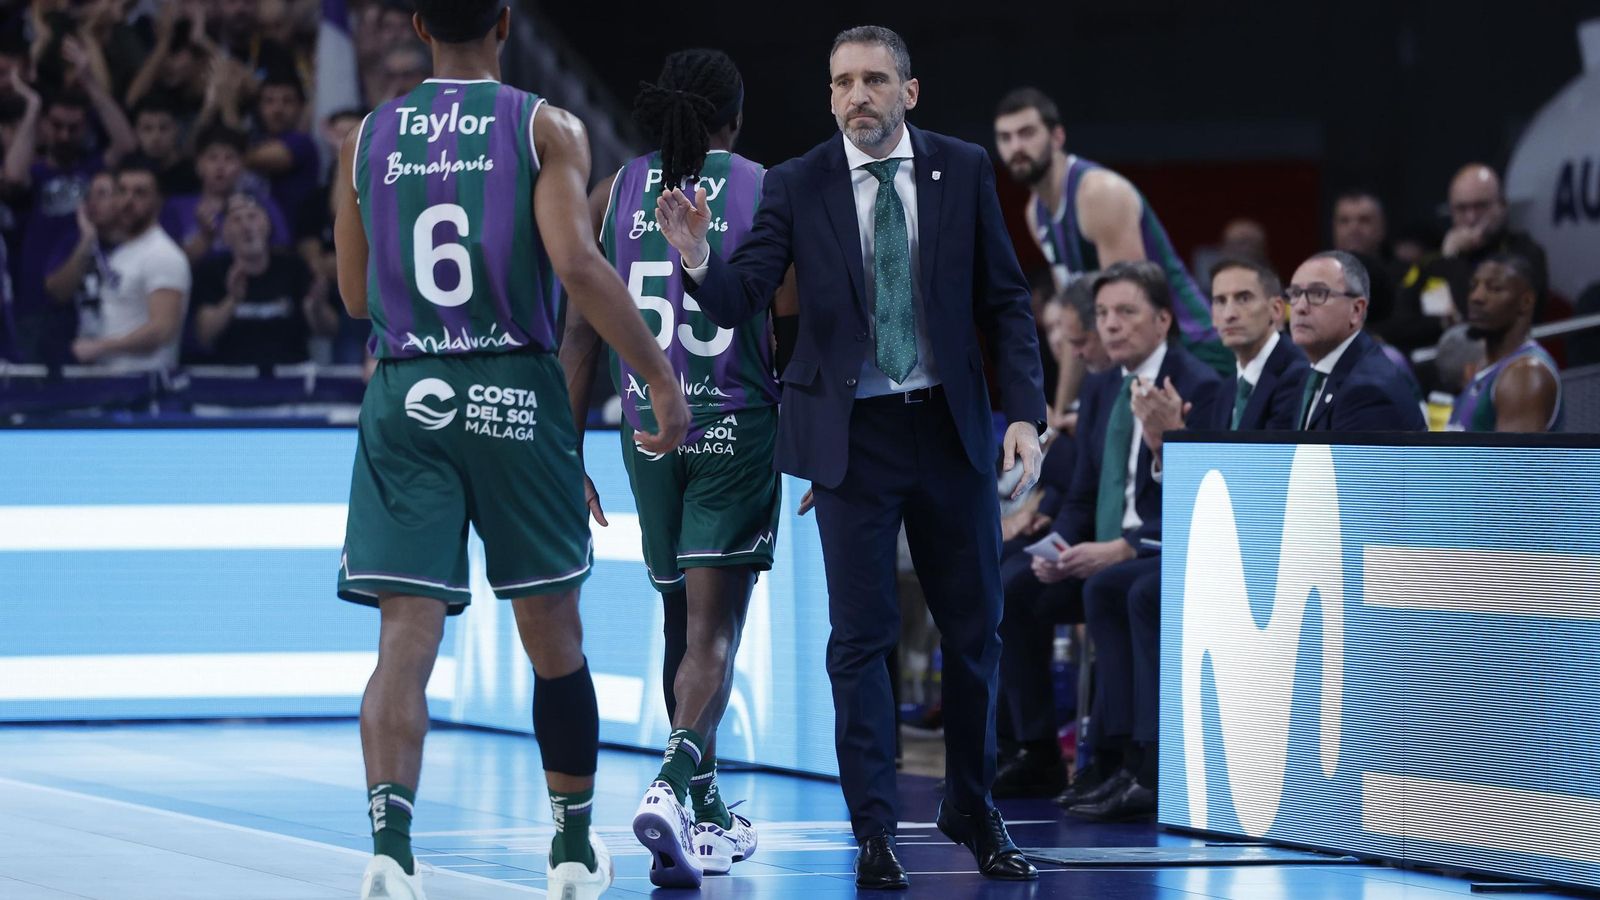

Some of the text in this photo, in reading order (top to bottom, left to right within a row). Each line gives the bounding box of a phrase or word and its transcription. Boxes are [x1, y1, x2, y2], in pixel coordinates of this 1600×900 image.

[396, 103, 496, 143] Taylor
[645, 168, 727, 201] Prry
[413, 203, 474, 308] 6
[402, 322, 523, 353] Andalucía
[468, 384, 538, 409] COSTA
[466, 403, 537, 426] DEL SOL
[465, 420, 534, 441] MÁLAGA
